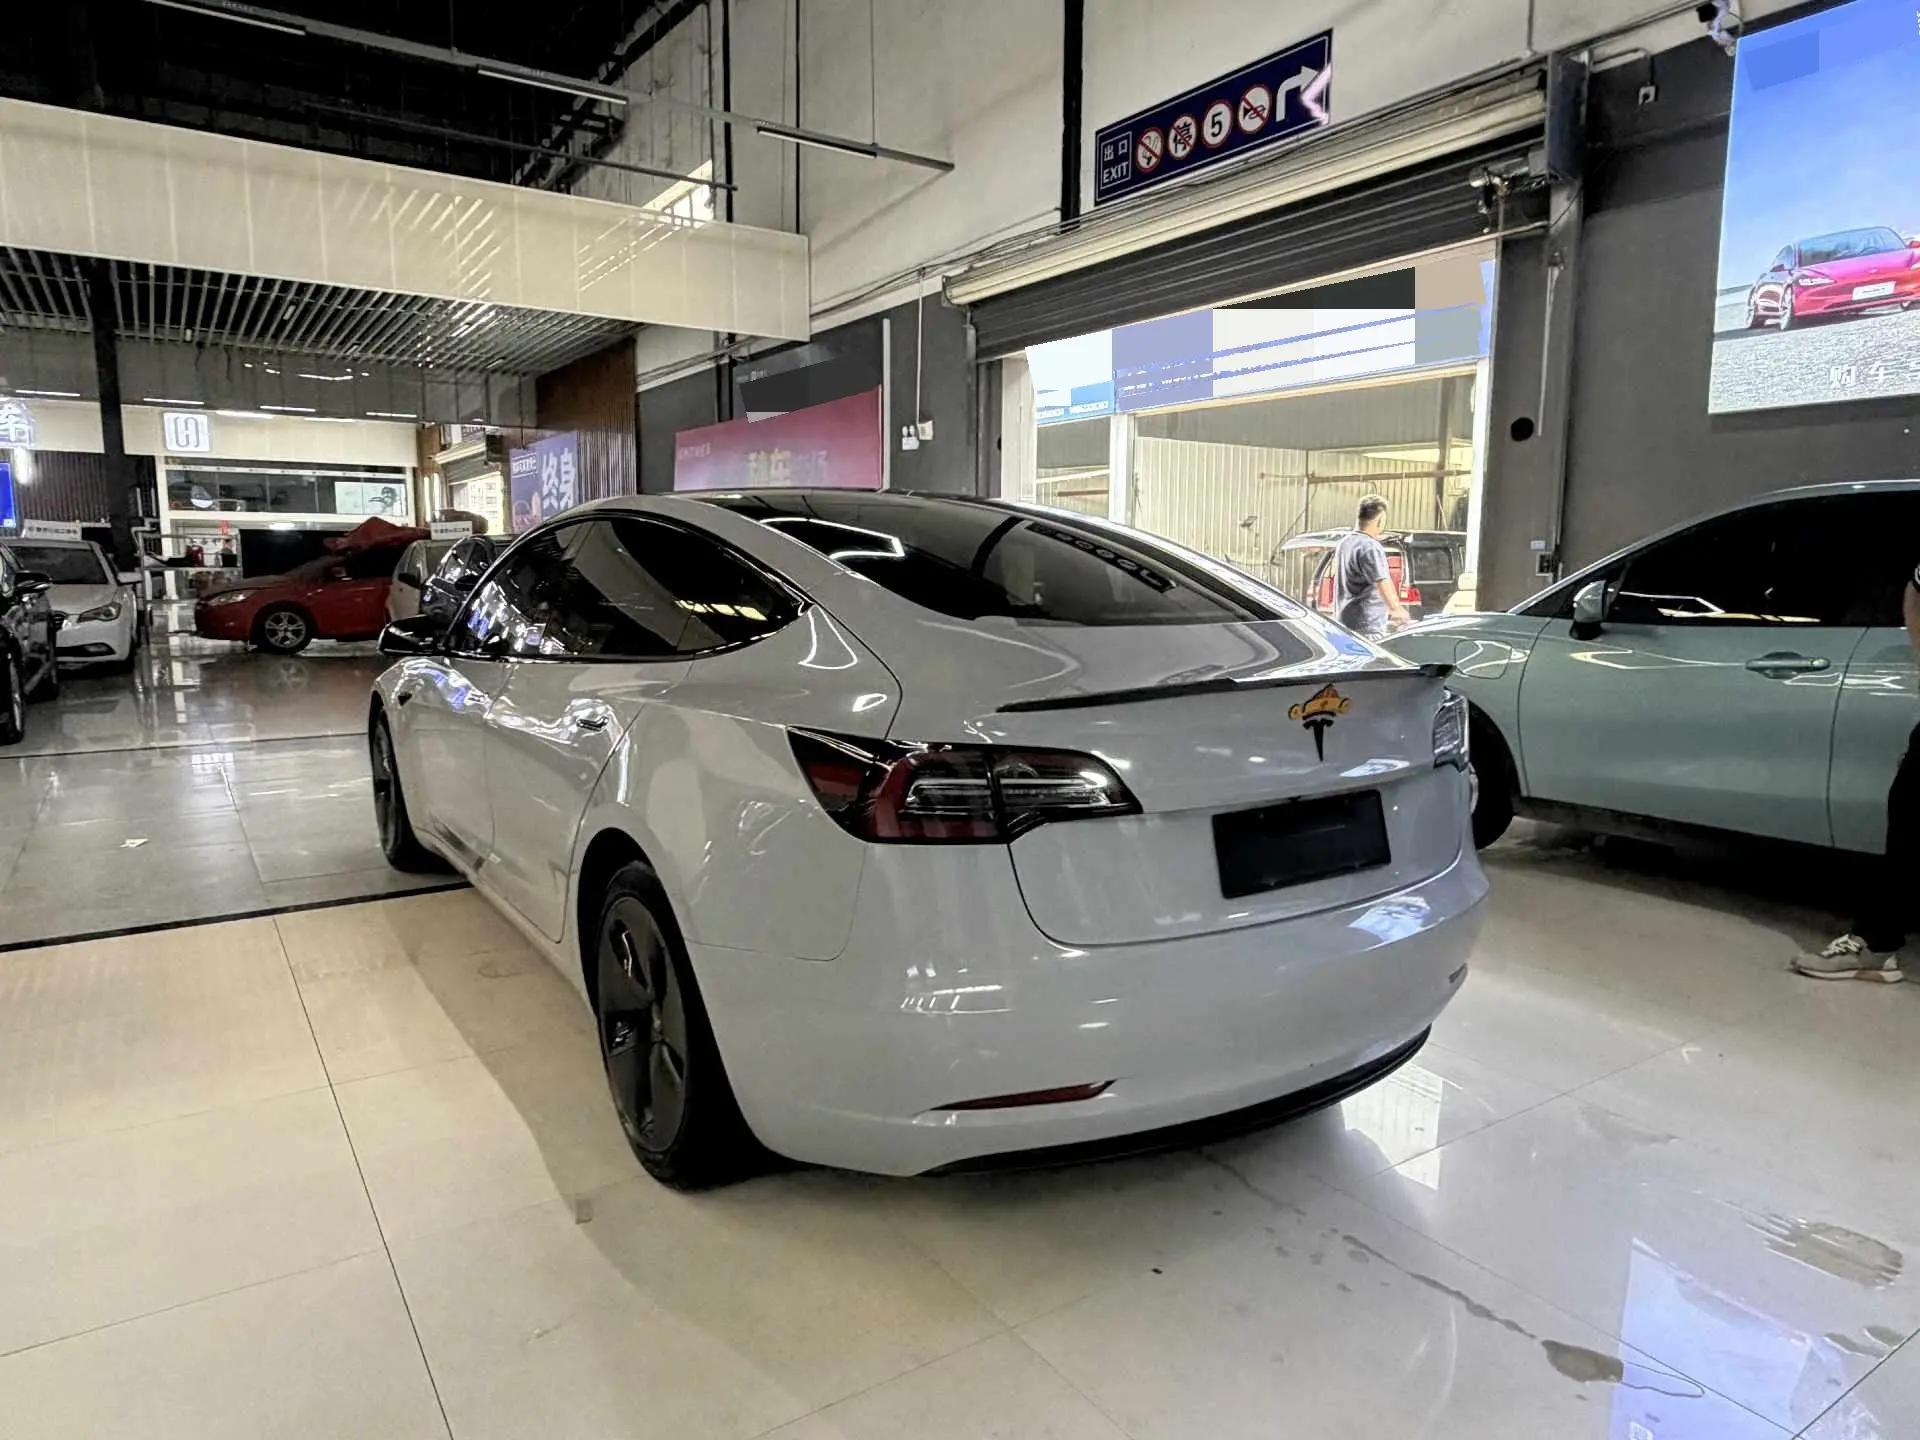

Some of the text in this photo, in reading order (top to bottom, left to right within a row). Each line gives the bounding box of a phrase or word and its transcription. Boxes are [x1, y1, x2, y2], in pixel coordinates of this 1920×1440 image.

[1211, 112, 1222, 137] 5
[1104, 140, 1127, 161] 出口
[1103, 161, 1128, 183] EXIT
